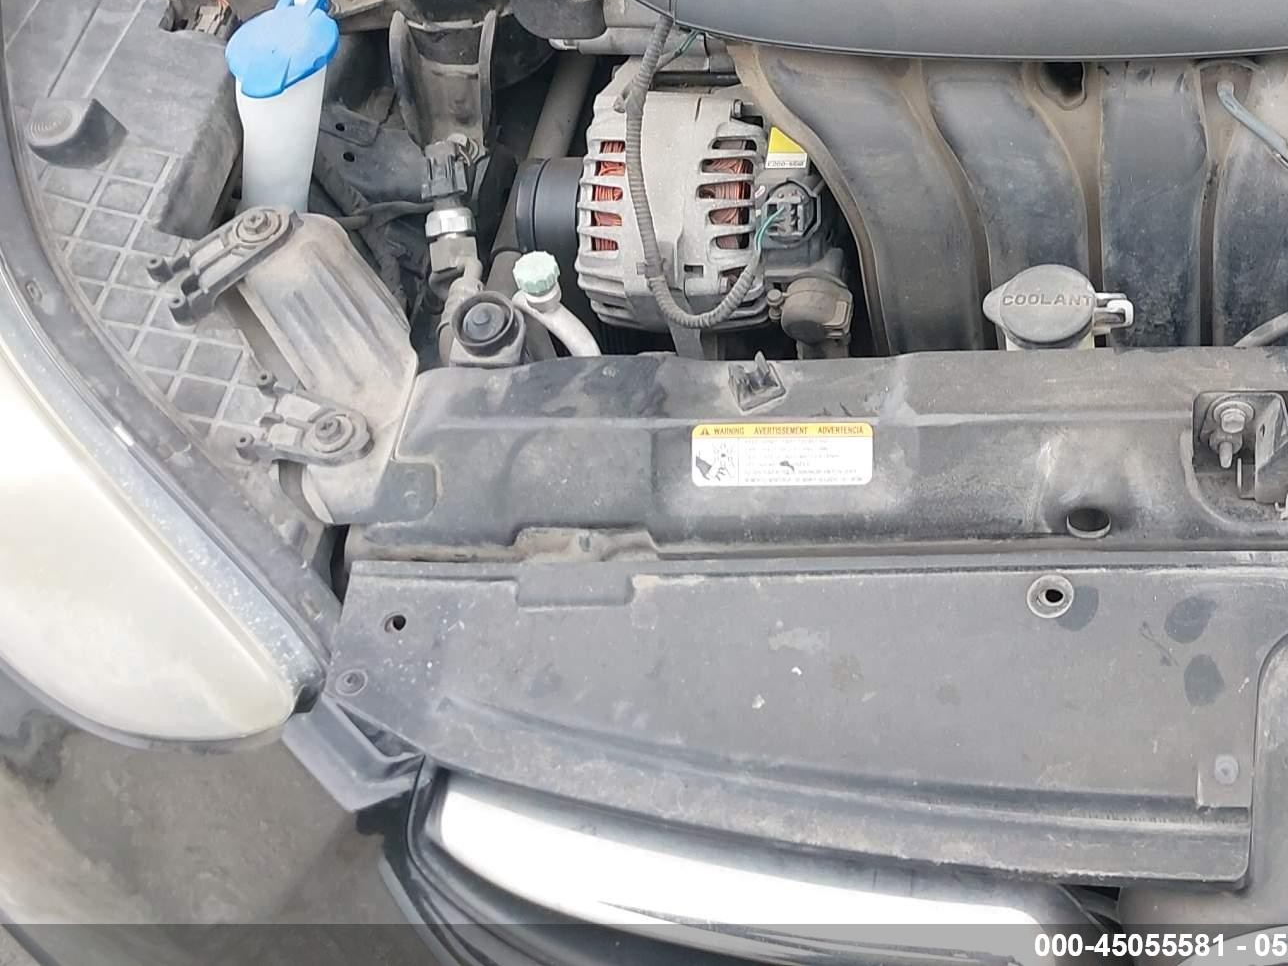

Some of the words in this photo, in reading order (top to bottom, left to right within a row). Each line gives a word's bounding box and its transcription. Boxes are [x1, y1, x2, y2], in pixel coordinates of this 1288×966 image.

[1002, 294, 1091, 306] COOLANT
[713, 426, 745, 435] WARNING
[754, 426, 808, 435] AVERTISSEMENT
[817, 425, 864, 434] ADVERTENCIA
